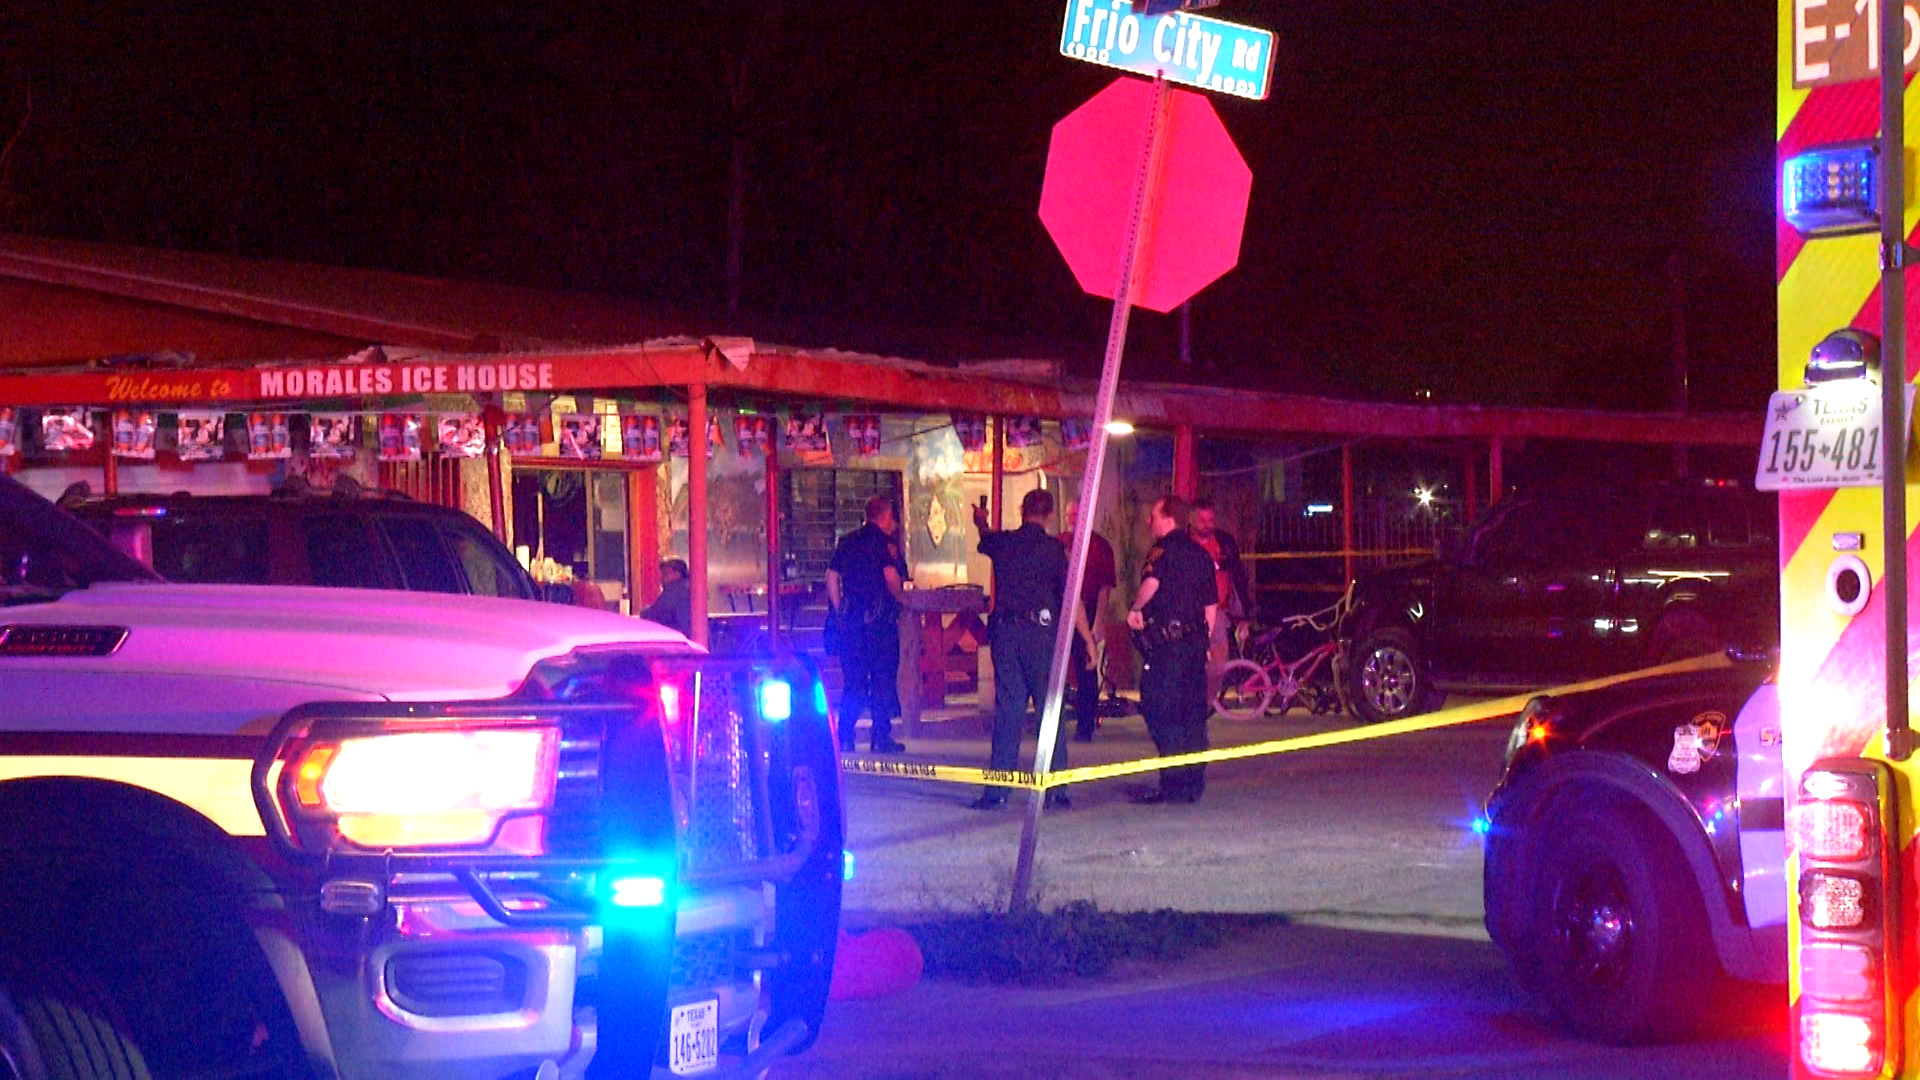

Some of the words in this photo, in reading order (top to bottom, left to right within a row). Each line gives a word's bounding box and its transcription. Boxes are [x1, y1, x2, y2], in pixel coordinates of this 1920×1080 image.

[1072, 0, 1140, 55] Frio
[1153, 14, 1222, 86] City
[1231, 38, 1261, 71] Rd
[106, 374, 201, 400] Welcome
[210, 379, 232, 396] to
[260, 367, 393, 396] MORALES
[402, 366, 449, 393] ICE
[457, 363, 553, 391] HOUSE
[1813, 397, 1868, 415] TES
